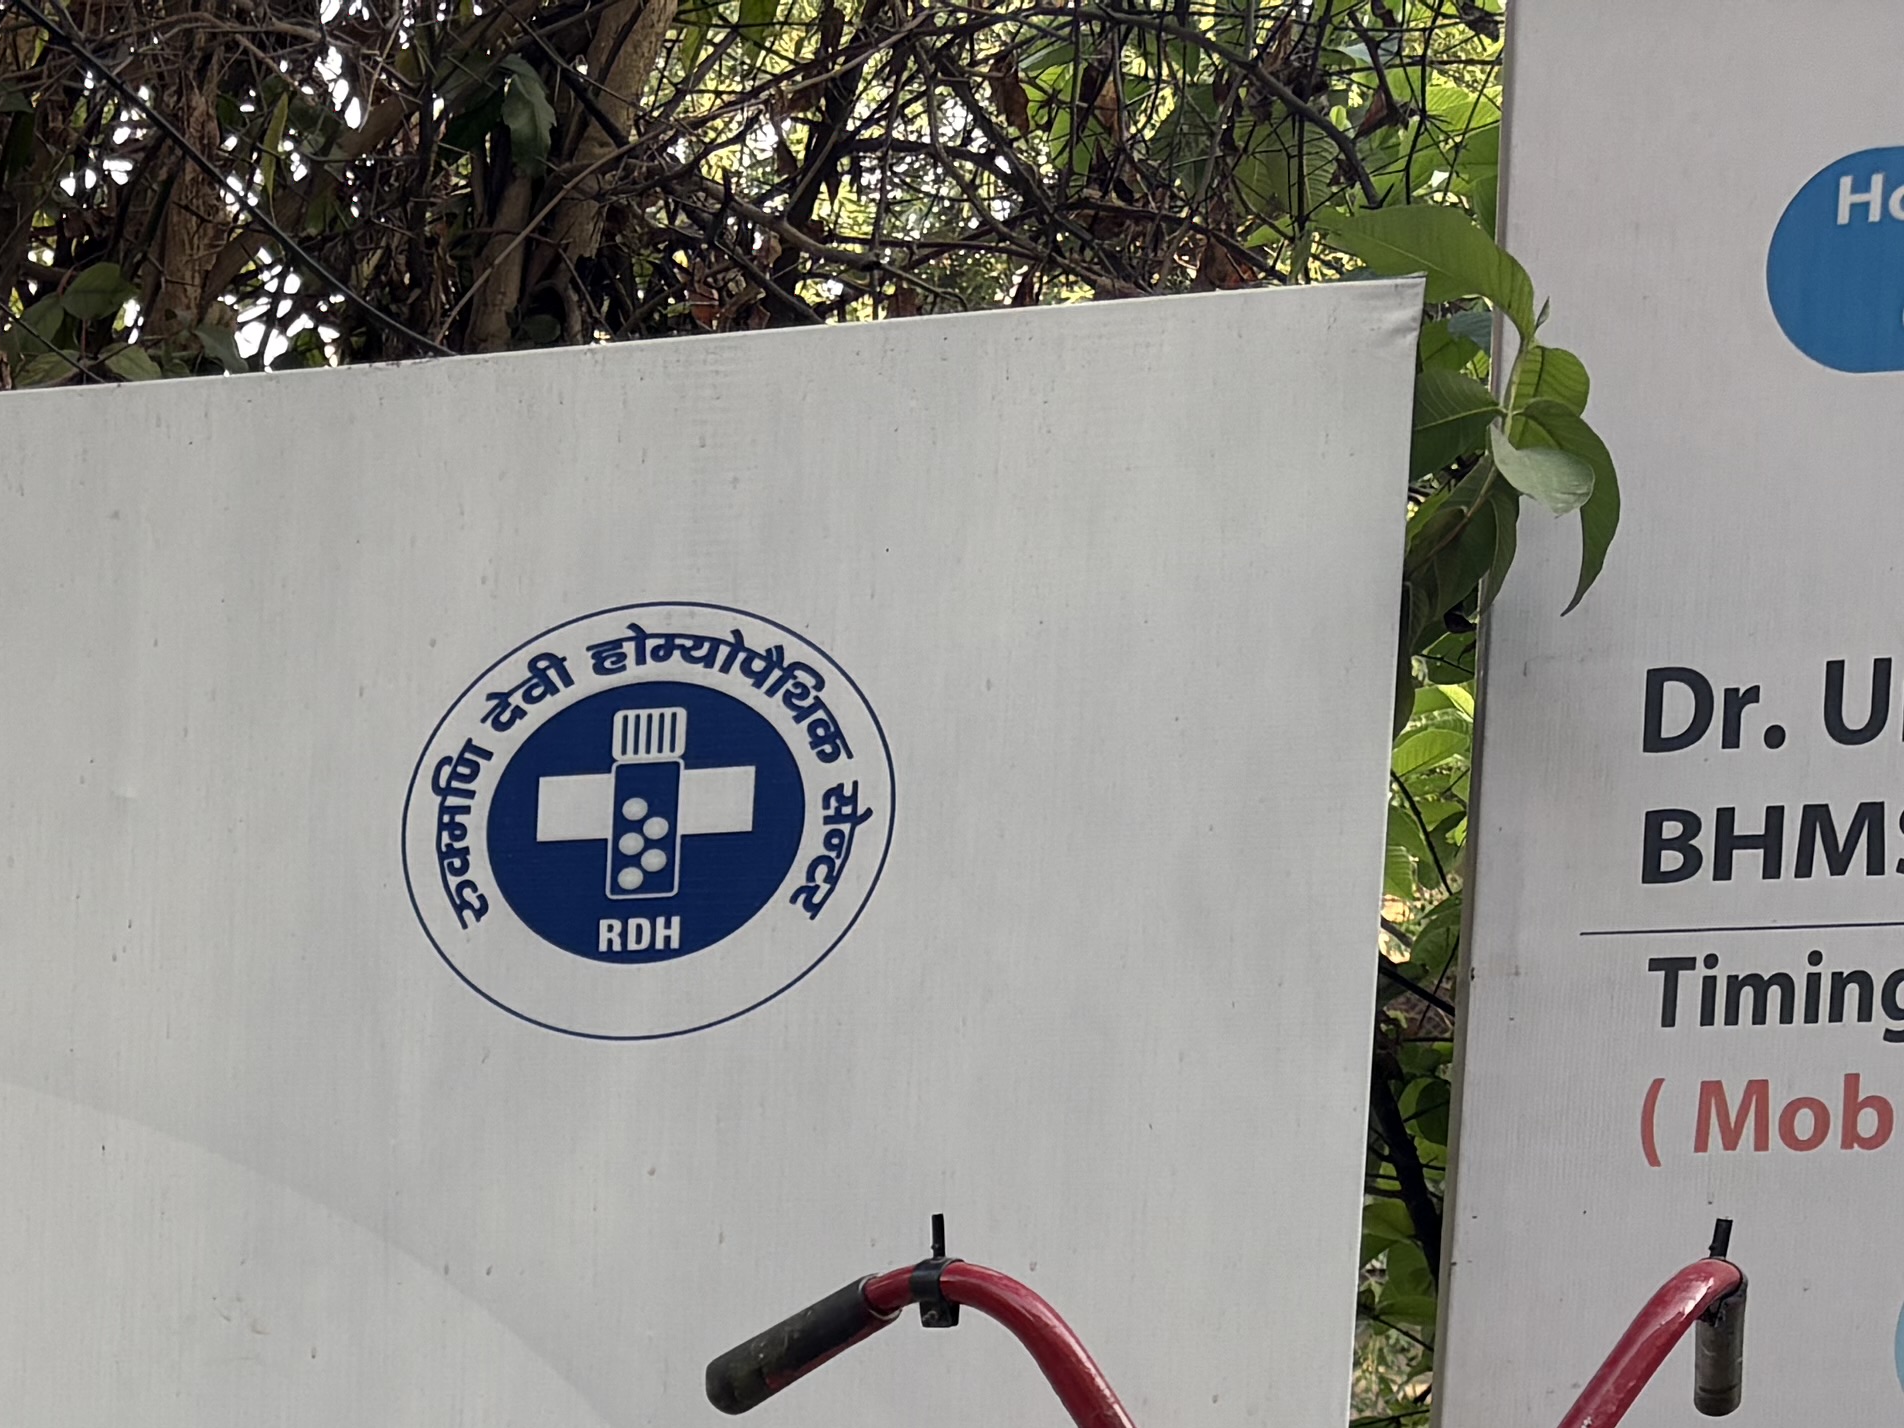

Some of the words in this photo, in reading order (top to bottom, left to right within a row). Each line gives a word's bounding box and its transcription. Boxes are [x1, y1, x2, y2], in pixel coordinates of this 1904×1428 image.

[1643, 666, 1786, 754] Dr.
[1823, 657, 1904, 746] U
[480, 651, 576, 733] देवी
[586, 622, 854, 765] होम्योपैथिक
[788, 779, 873, 921] सेन्टर
[1641, 801, 1904, 885] BHM
[598, 915, 681, 952] RDH
